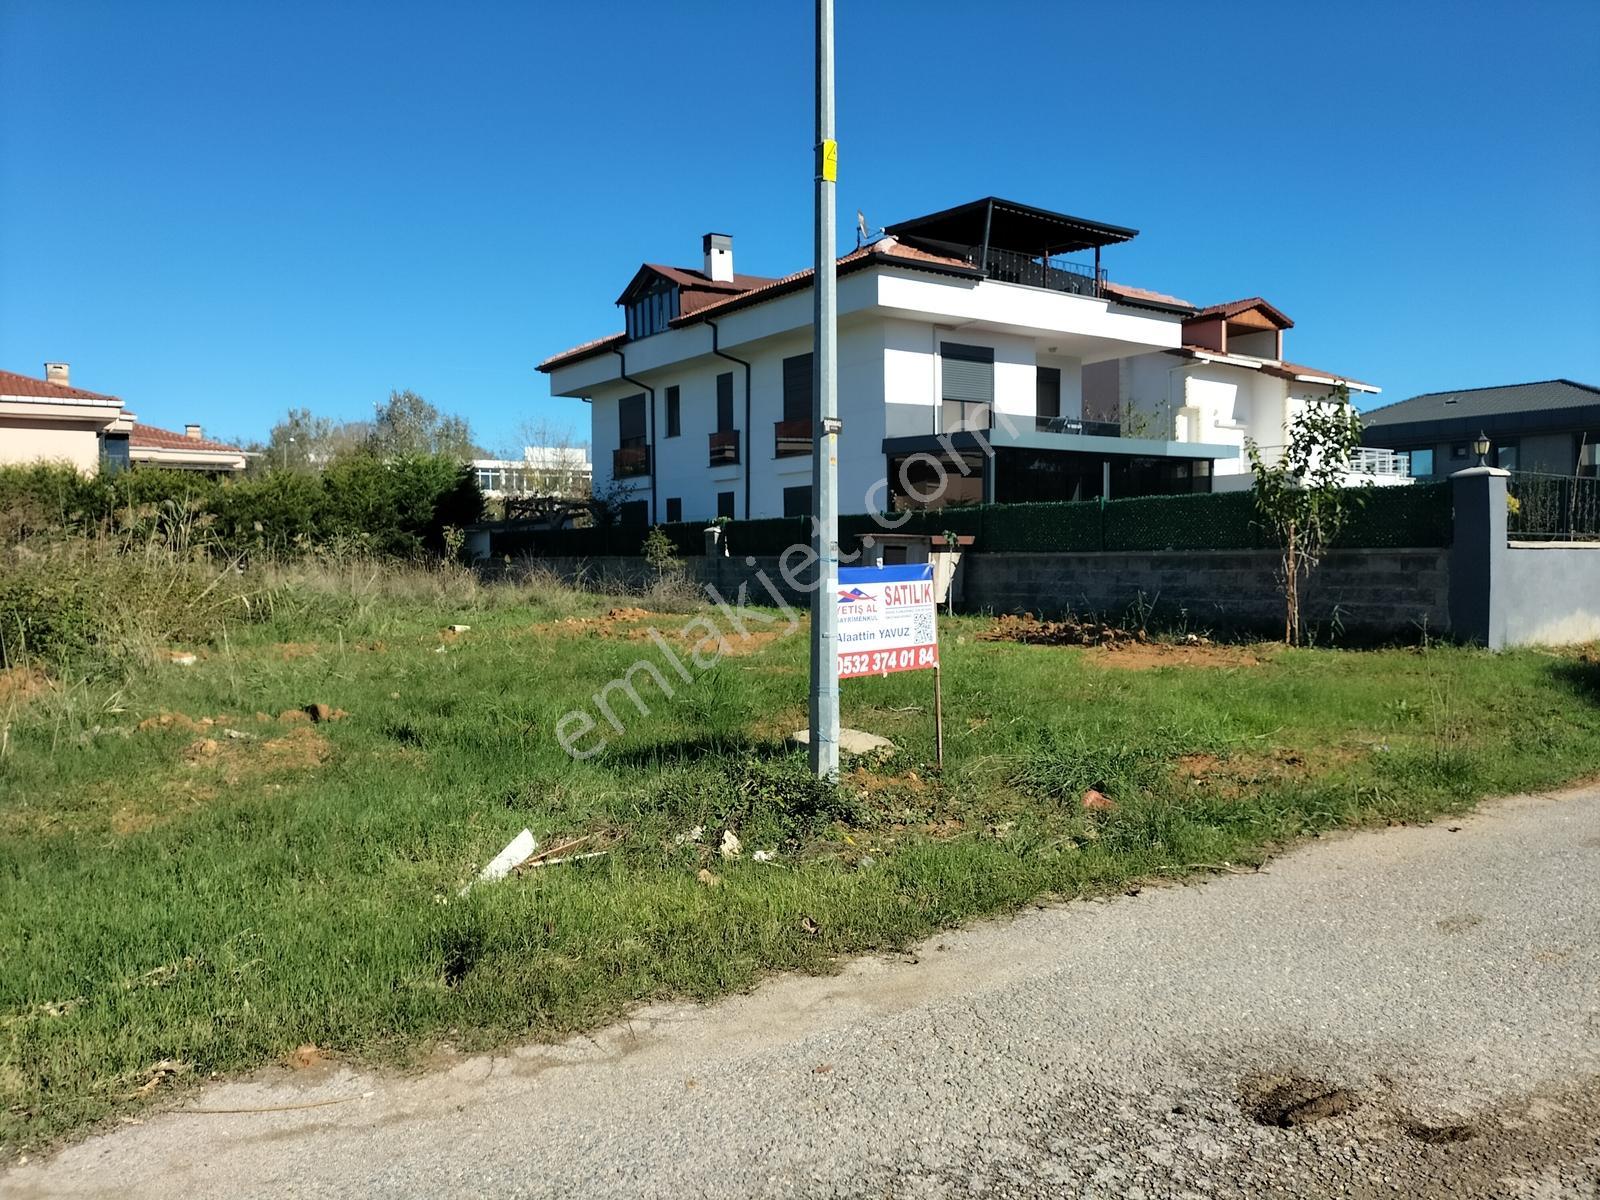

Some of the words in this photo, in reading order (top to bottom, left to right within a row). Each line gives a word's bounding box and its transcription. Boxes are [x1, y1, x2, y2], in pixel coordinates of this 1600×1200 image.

[884, 583, 932, 606] SATILIK
[866, 603, 878, 613] AL
[837, 631, 875, 642] Alaattin
[879, 627, 910, 639] YAVUZ
[872, 651, 897, 671] 374
[900, 648, 915, 667] 01
[918, 646, 935, 665] 84
